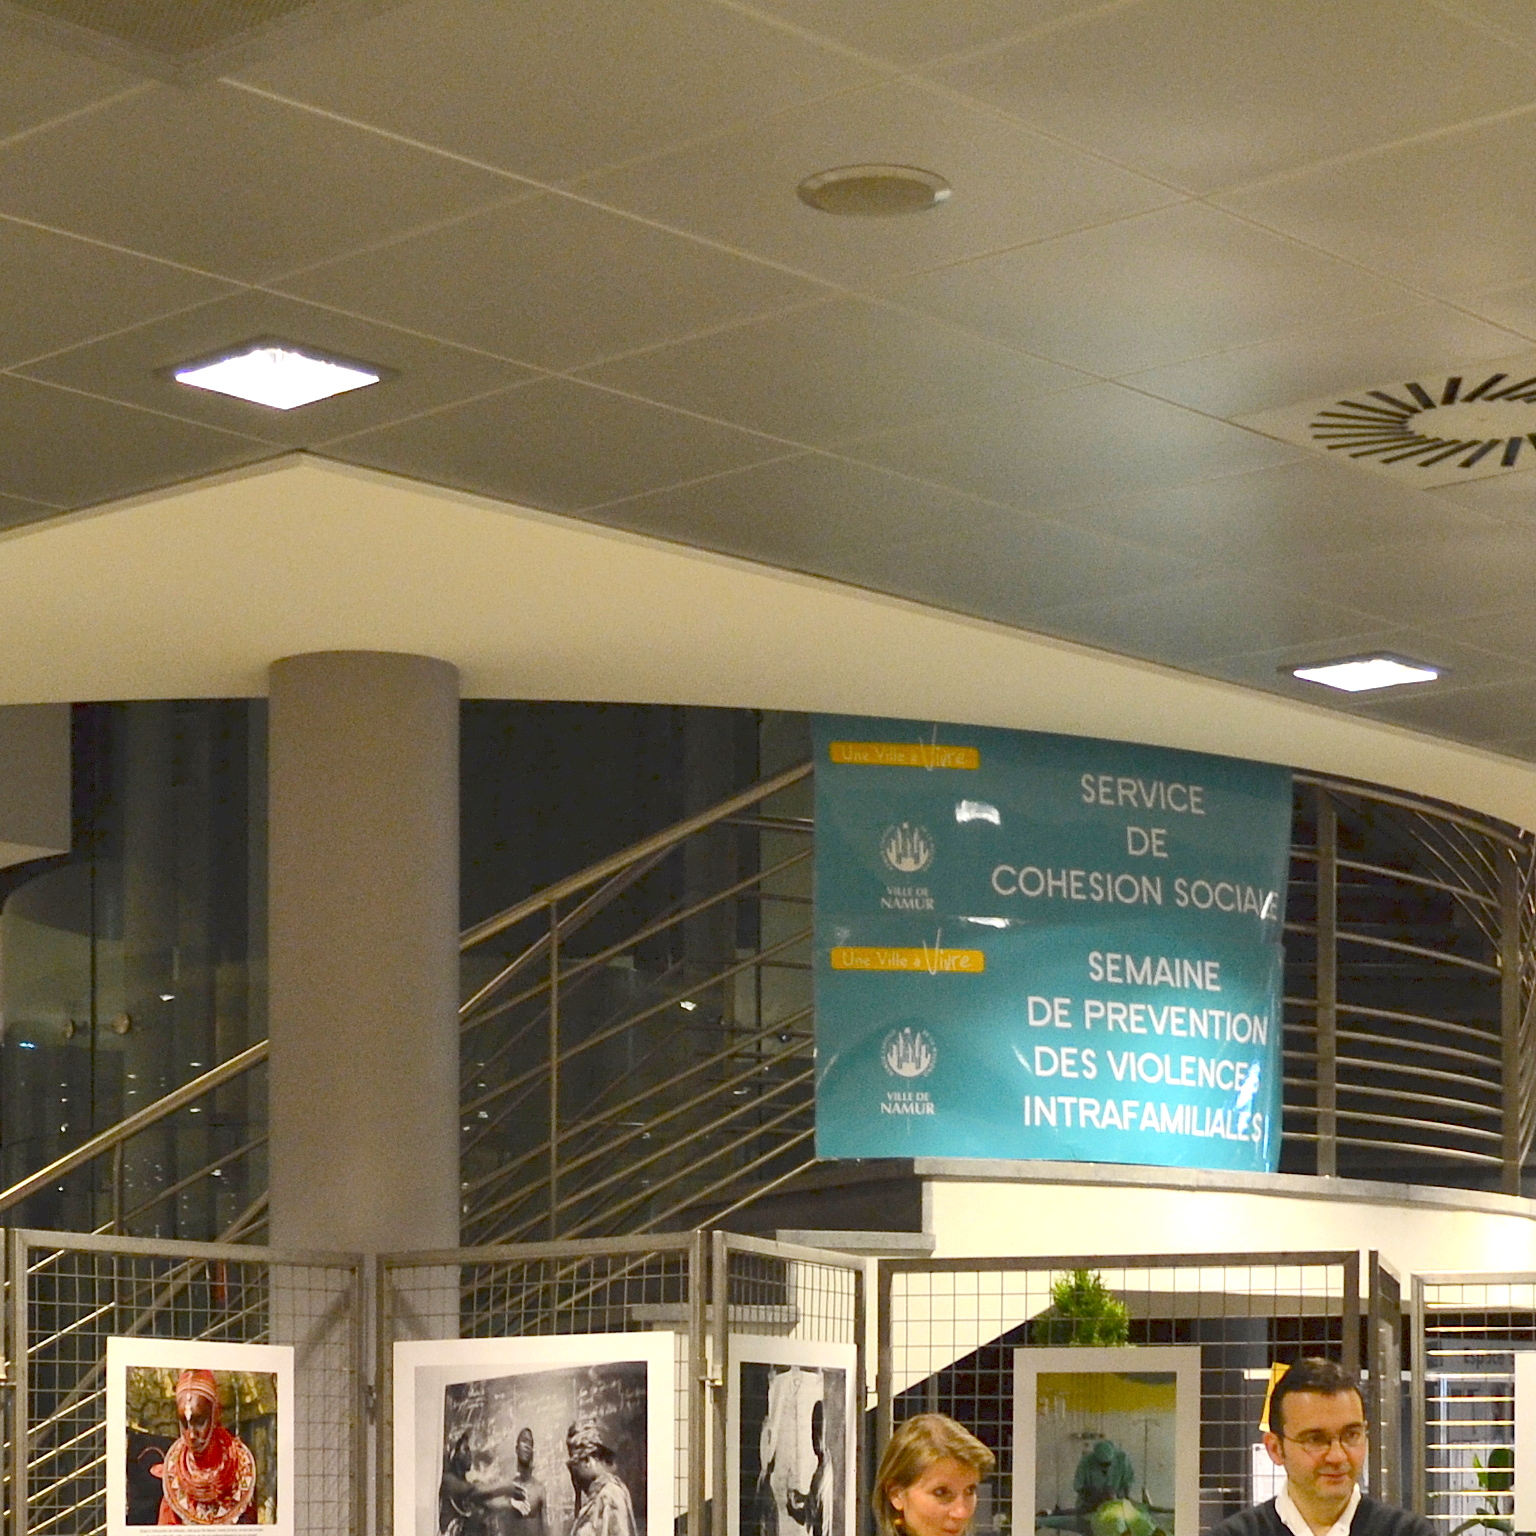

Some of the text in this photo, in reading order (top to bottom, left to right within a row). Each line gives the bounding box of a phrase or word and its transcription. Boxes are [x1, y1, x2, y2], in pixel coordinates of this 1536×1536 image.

[1081, 773, 1206, 815] SERVICE
[1126, 826, 1168, 858] DE
[886, 886, 929, 896] VILLE DE
[991, 864, 1163, 905] COHESION
[881, 898, 935, 910] NAMUR
[842, 950, 871, 967] Une
[876, 951, 909, 968] Ville
[1088, 950, 1222, 991] SEMAINE
[1027, 996, 1268, 1045] DE PREVENTION
[1034, 1046, 1098, 1079] DES
[881, 1103, 936, 1115] NAMUR
[886, 1092, 930, 1101] VILLE DE
[1024, 1095, 1262, 1142] INTRAFAMILIALES
